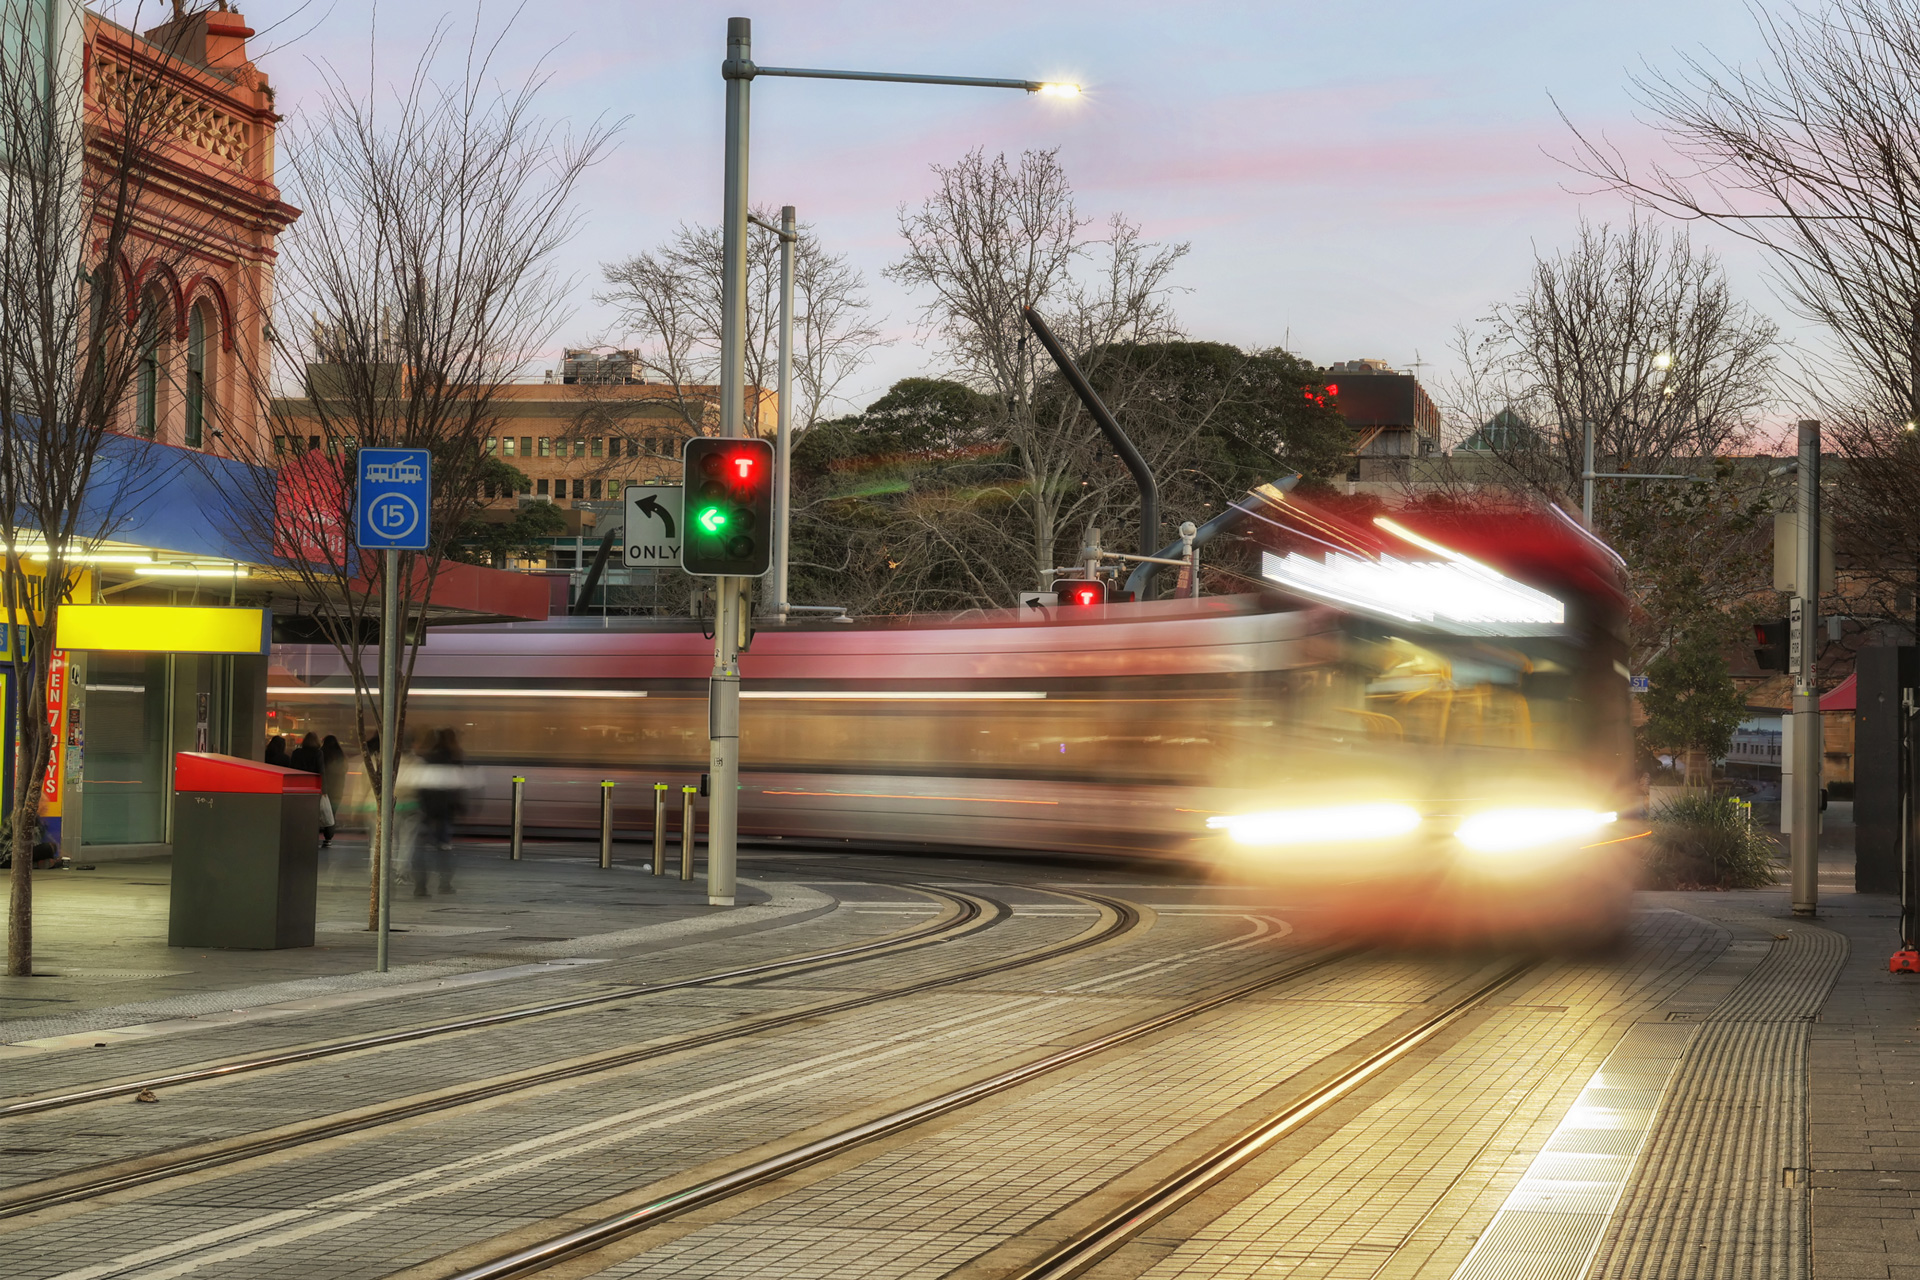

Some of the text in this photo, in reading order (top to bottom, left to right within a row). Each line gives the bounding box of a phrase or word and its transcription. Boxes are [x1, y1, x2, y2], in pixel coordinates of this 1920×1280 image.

[381, 504, 405, 528] 15
[630, 545, 681, 559] ONLY
[1792, 642, 1800, 654] FOR
[731, 654, 738, 663] H
[1632, 677, 1645, 687] ST
[1797, 677, 1802, 686] H
[48, 709, 60, 728] 7
